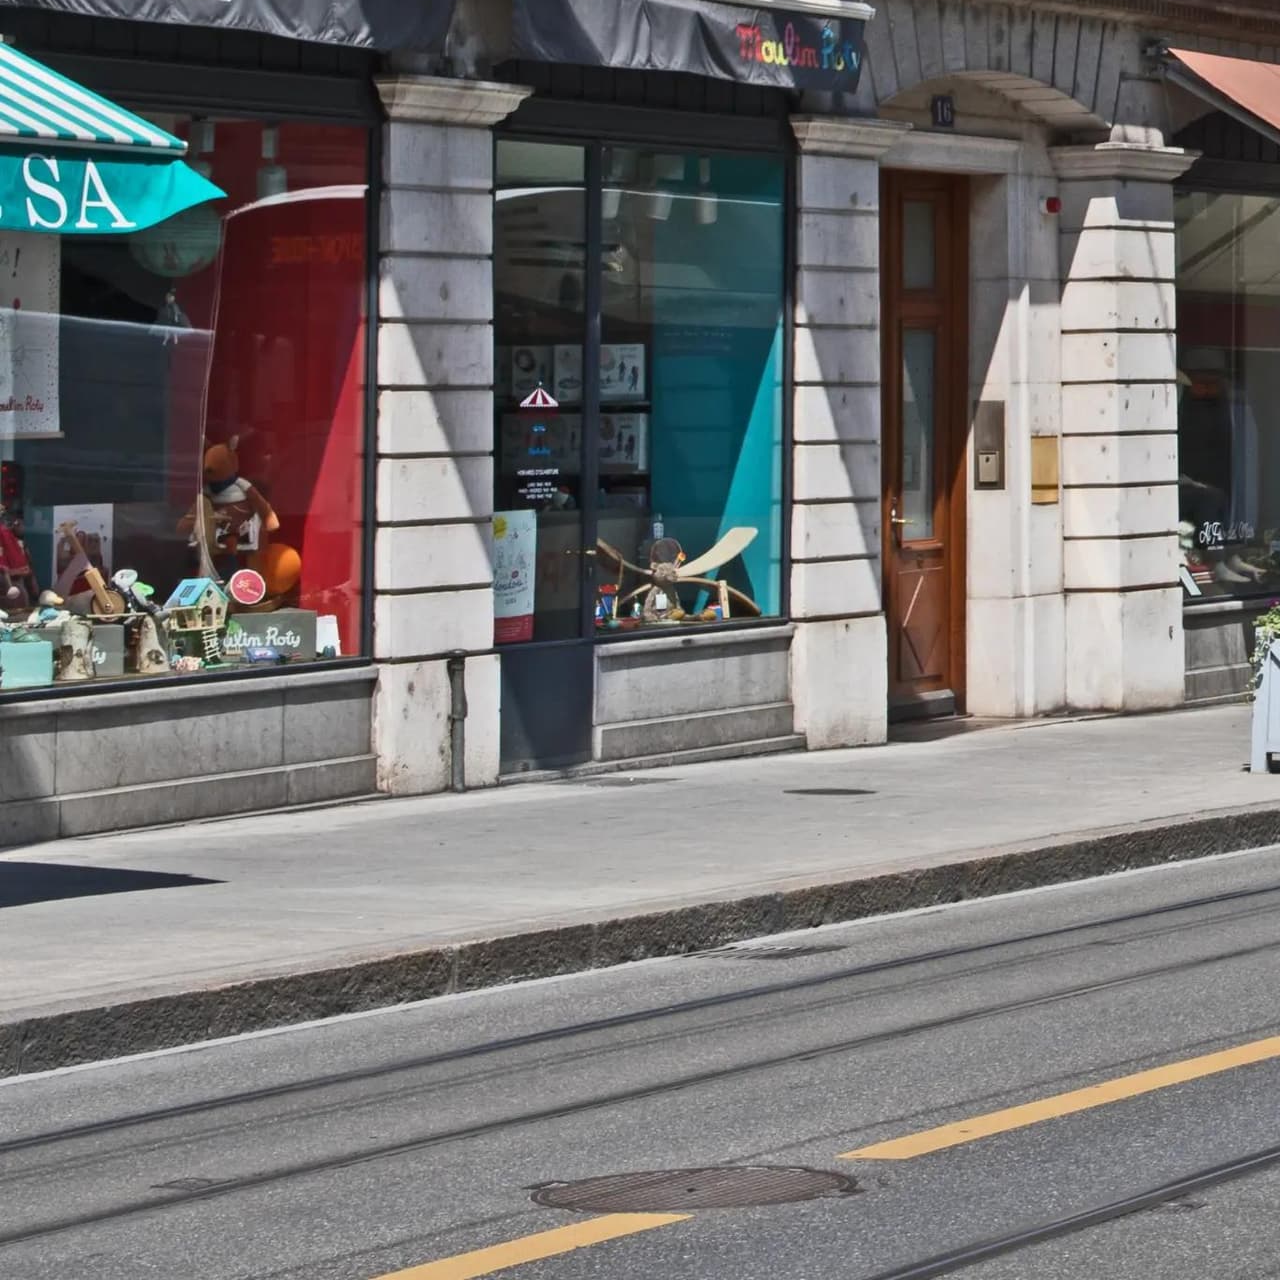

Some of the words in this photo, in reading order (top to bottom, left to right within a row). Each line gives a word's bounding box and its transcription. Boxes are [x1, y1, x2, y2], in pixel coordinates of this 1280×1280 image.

[736, 22, 819, 69] Moulin
[937, 100, 952, 122] 16
[23, 153, 136, 229] SA
[264, 626, 301, 648] Roty
